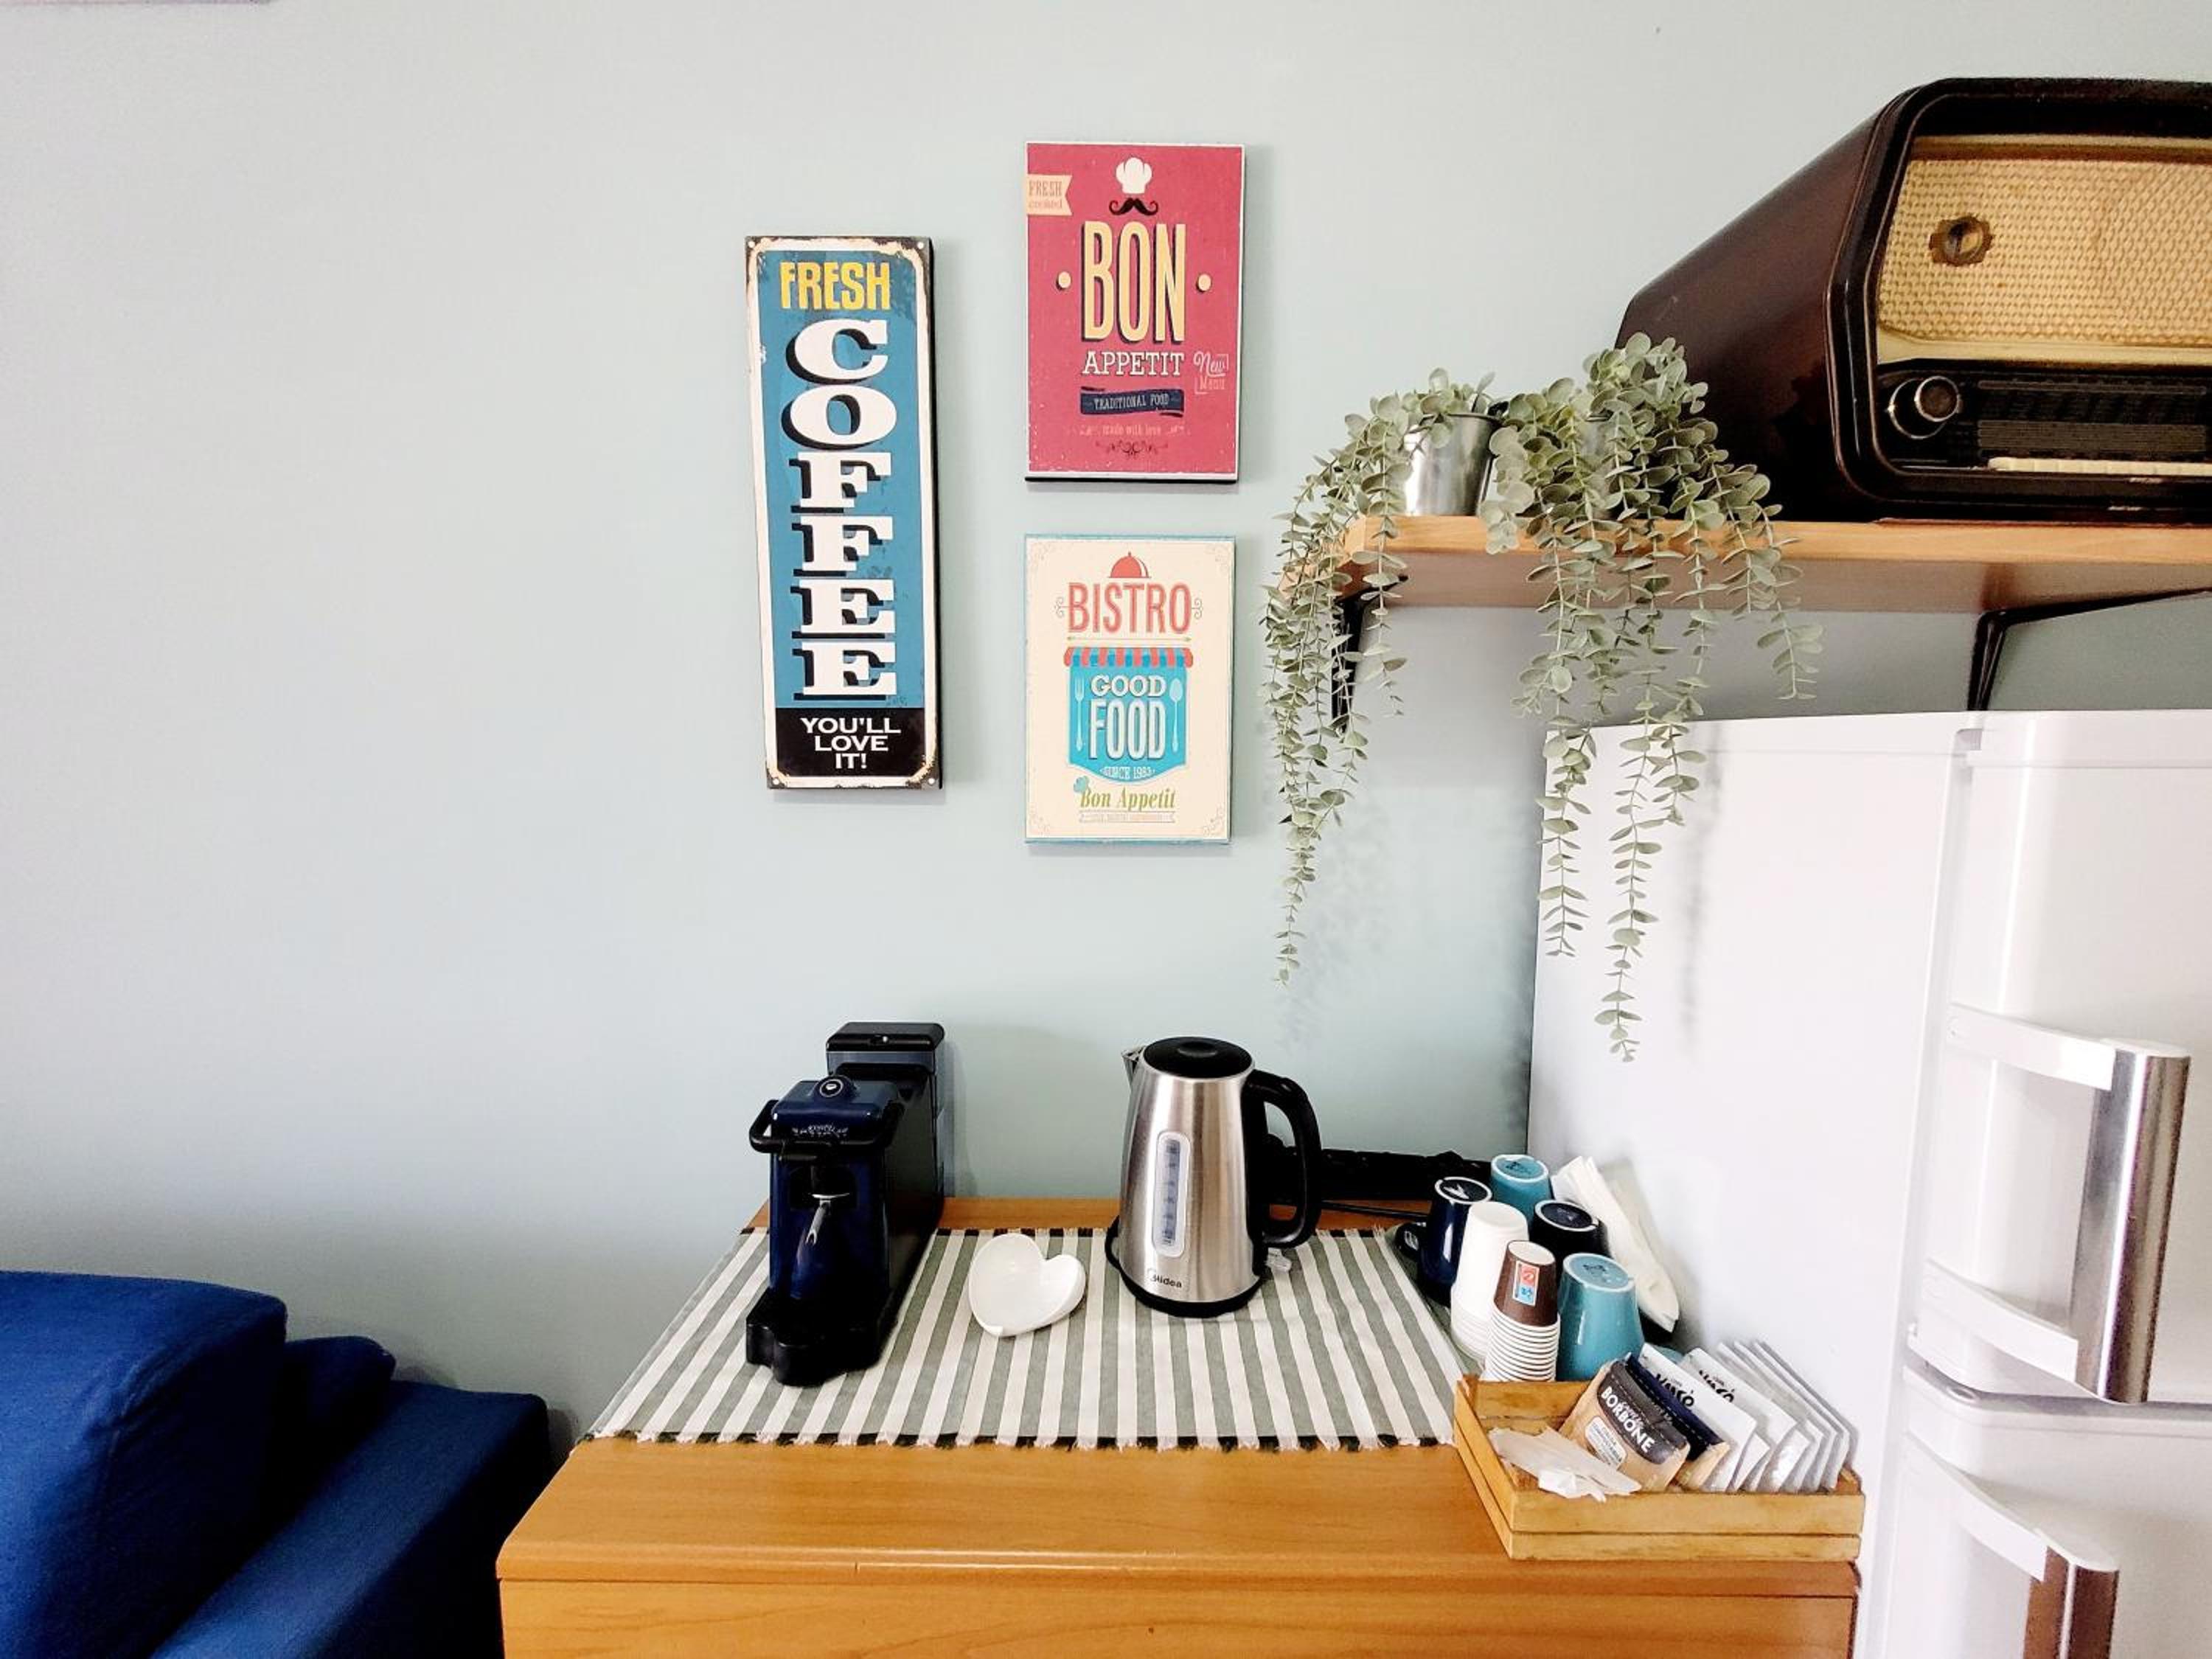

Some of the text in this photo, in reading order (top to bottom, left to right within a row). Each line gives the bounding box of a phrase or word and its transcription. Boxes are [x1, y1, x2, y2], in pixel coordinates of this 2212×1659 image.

[779, 261, 891, 310] FRESH
[1082, 220, 1186, 343] BON
[1082, 351, 1185, 376] APPETIT
[1193, 351, 1226, 378] New
[1093, 393, 1169, 411] TRADITIONAL FOOD
[782, 319, 897, 700] COFFEE
[1068, 582, 1192, 634] BISTRO
[1090, 674, 1167, 698] GOOD
[801, 717, 902, 734] YOU'LL
[1088, 698, 1166, 760] FOOD
[815, 735, 889, 752] LOVE
[835, 753, 868, 769] IT!
[1079, 785, 1176, 812] Bon Appetit
[1601, 1385, 1655, 1453] BORBONE
